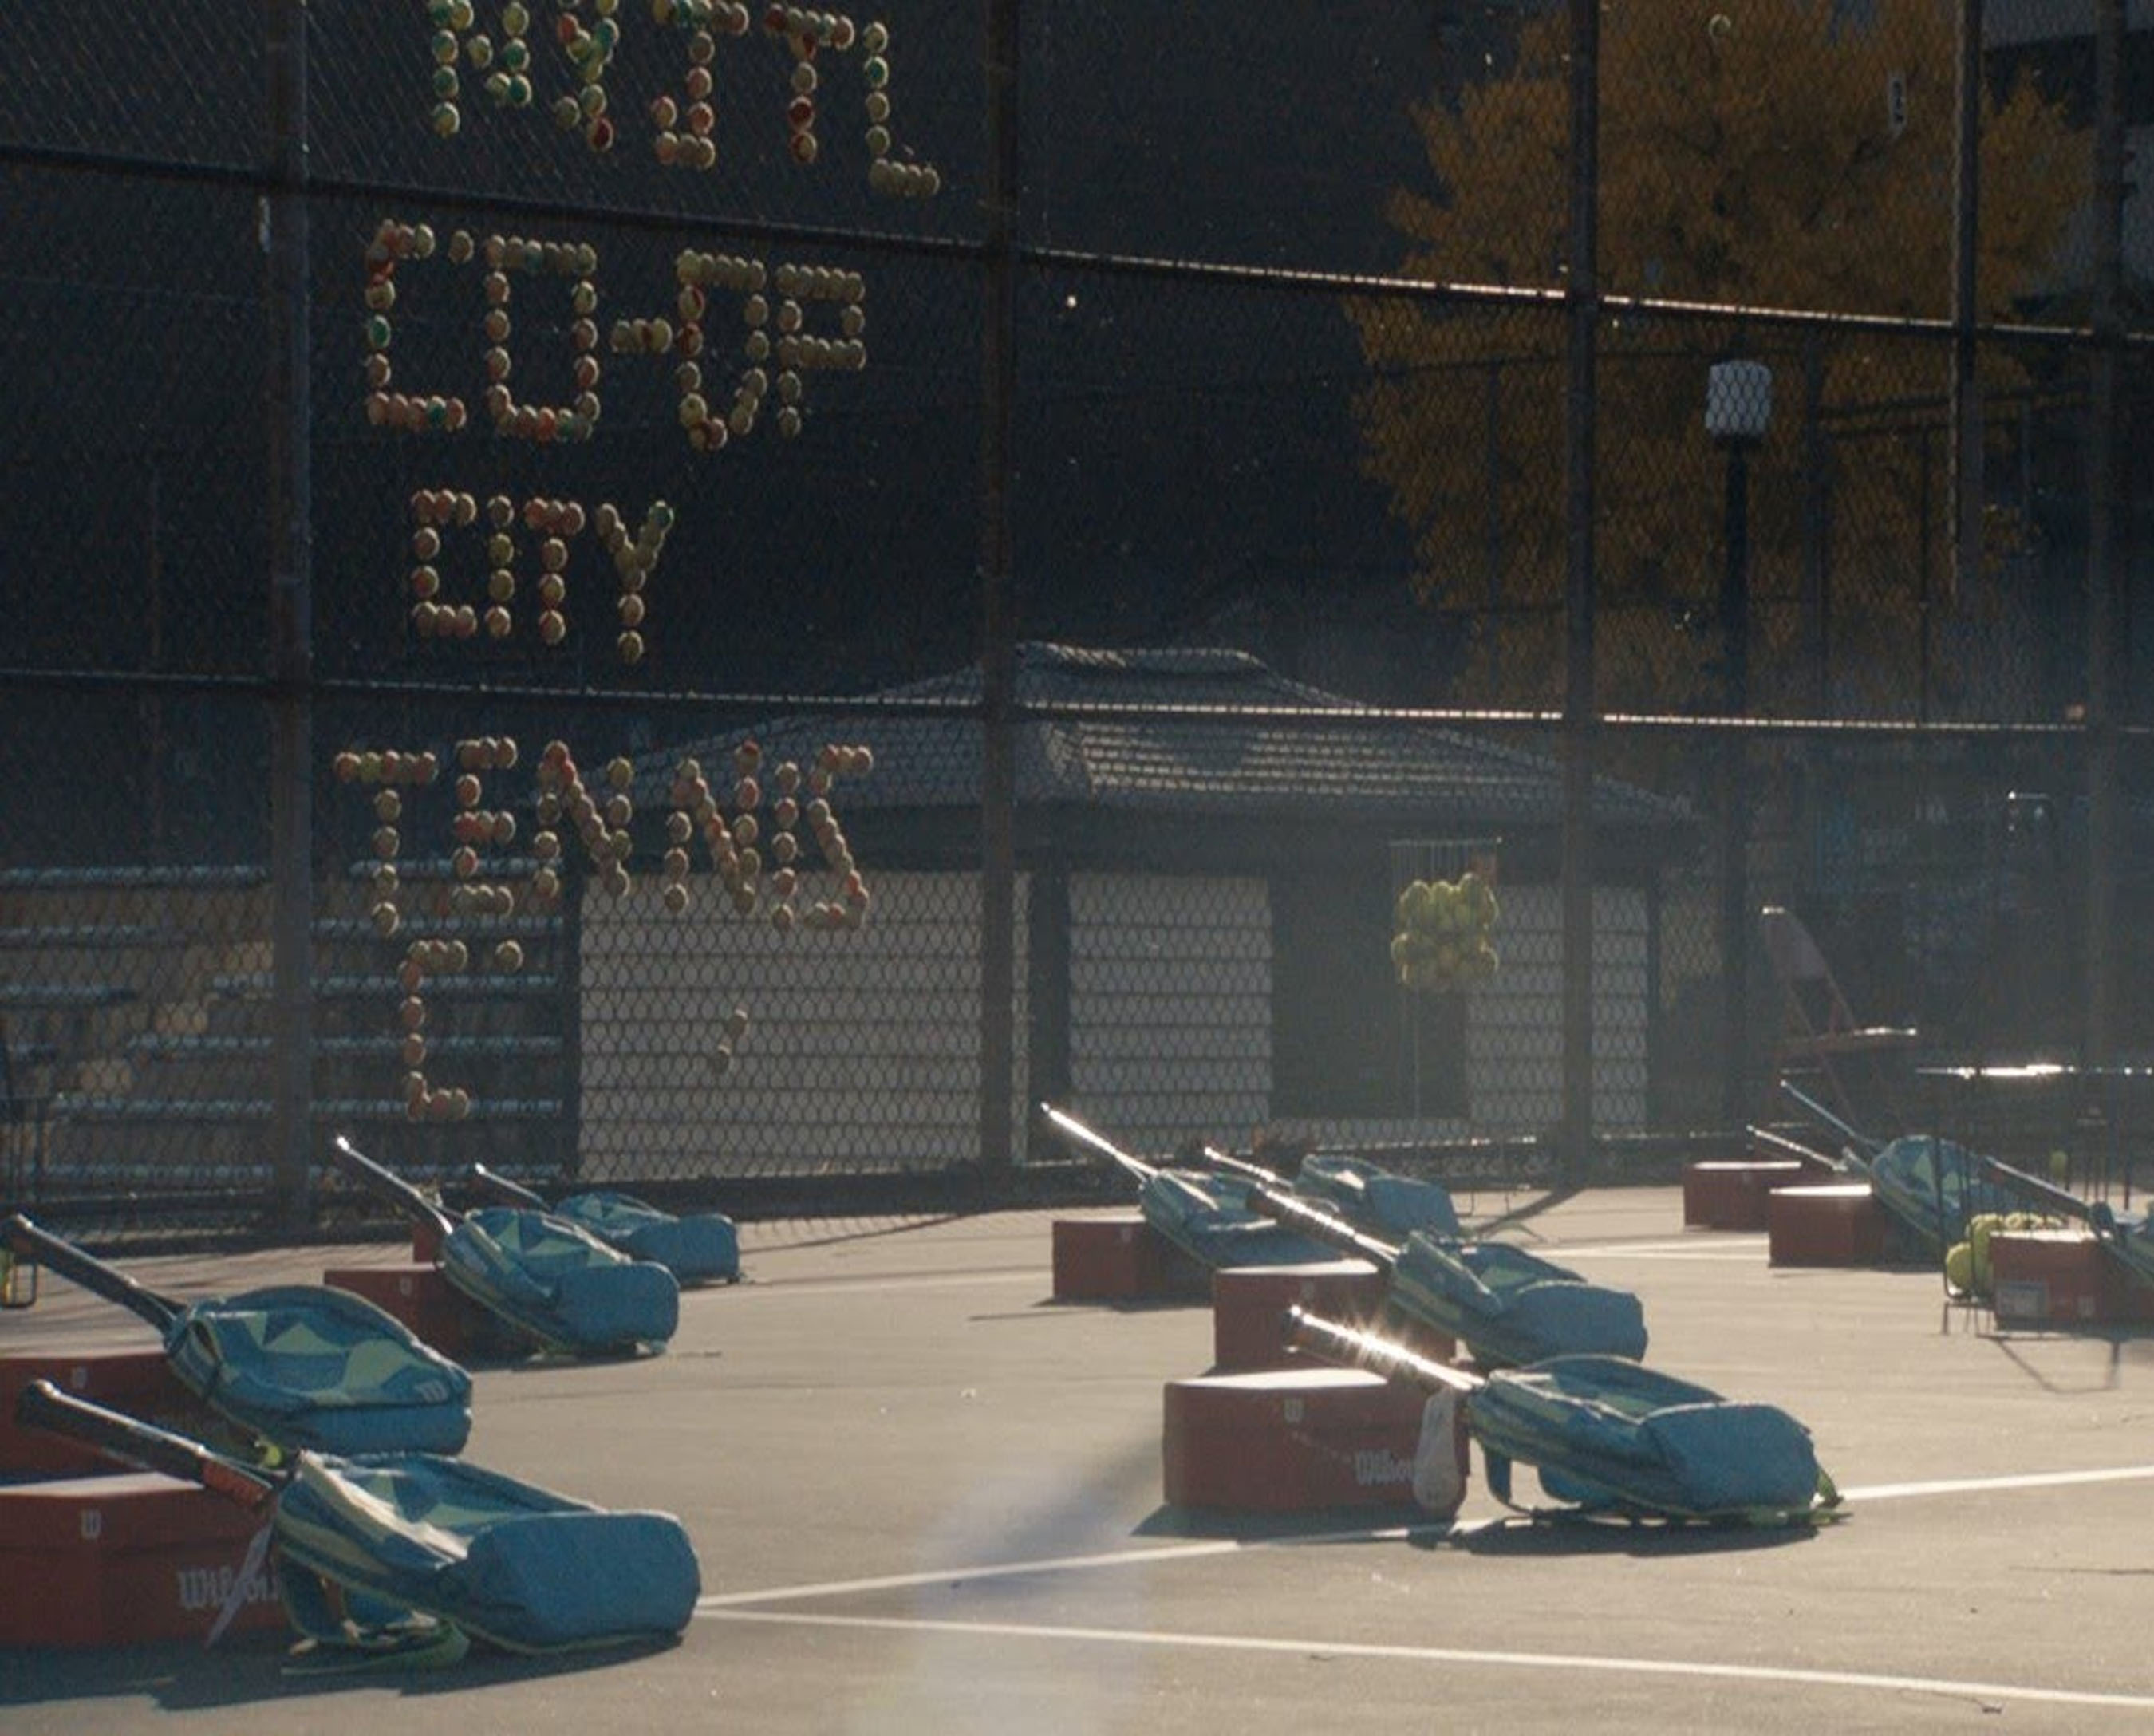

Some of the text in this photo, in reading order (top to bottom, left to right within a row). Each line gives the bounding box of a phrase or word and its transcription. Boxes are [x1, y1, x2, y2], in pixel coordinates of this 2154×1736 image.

[365, 219, 867, 452] CO-OP
[411, 488, 676, 664] CITY
[333, 736, 874, 937] TENNIS
